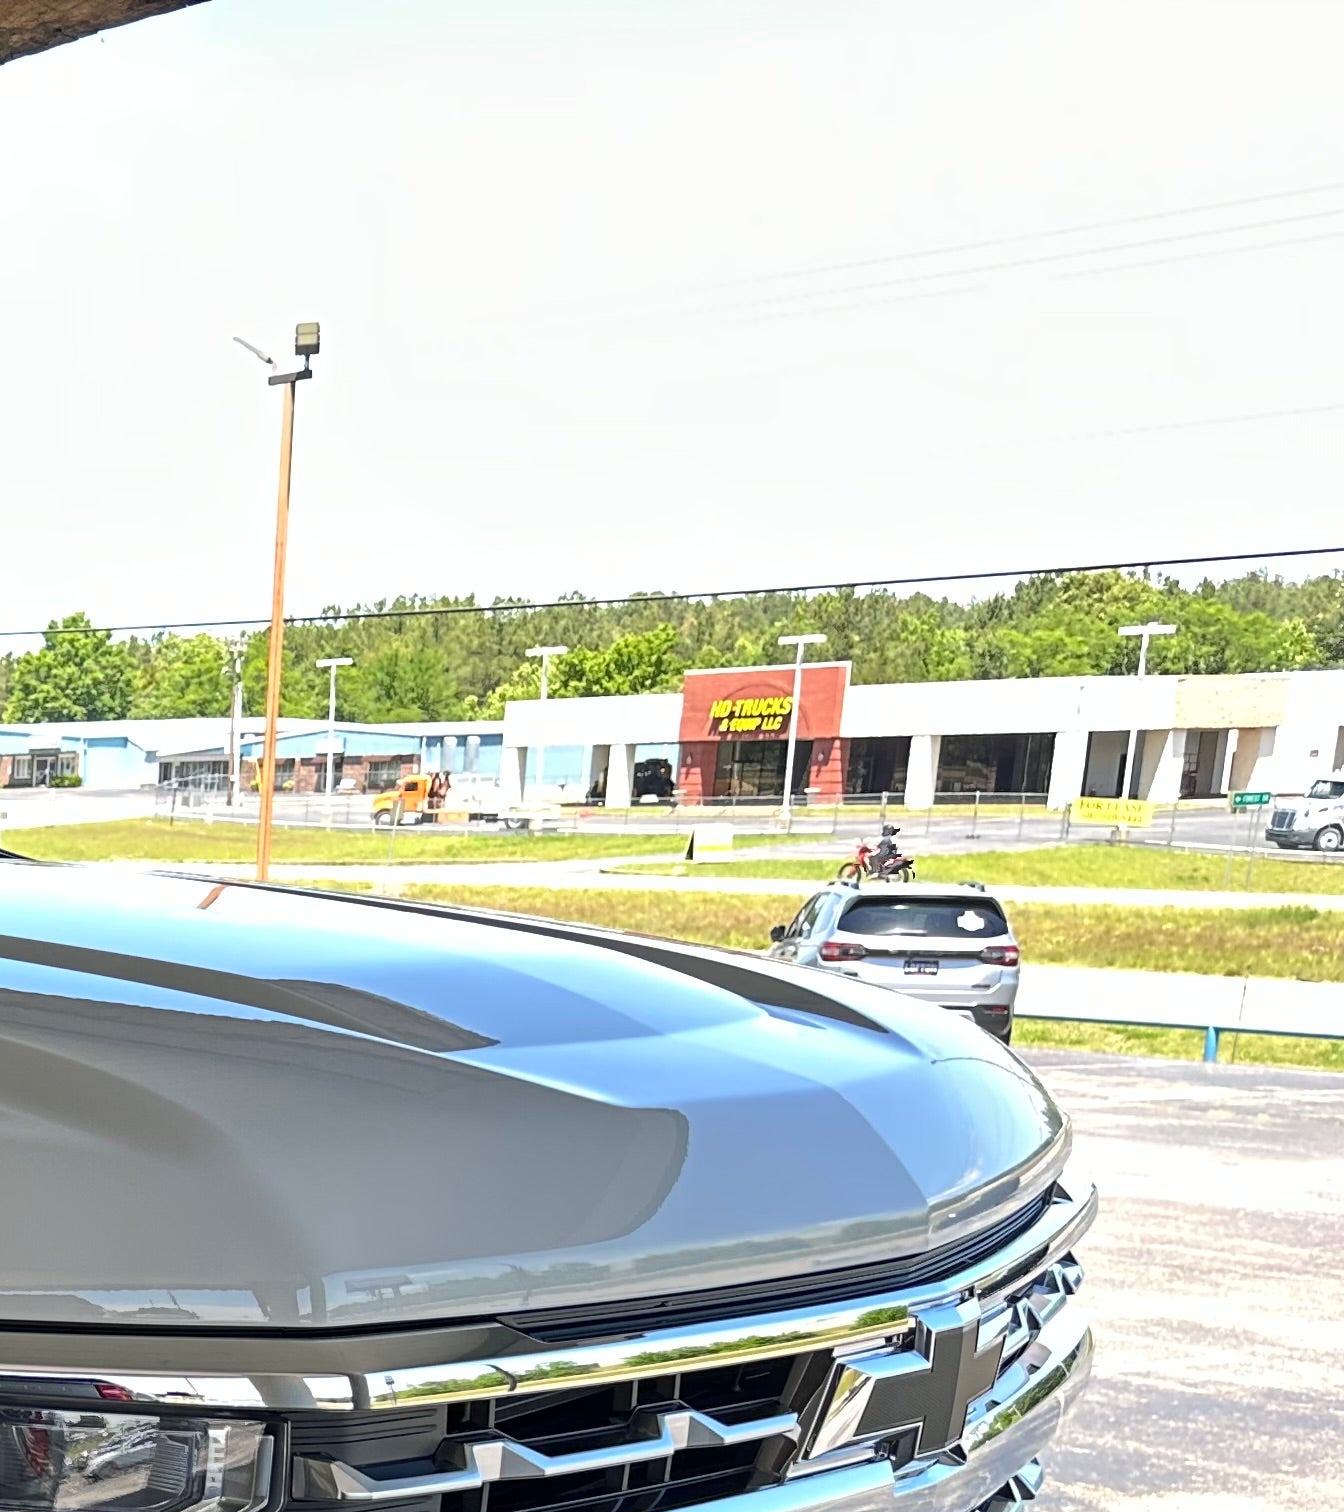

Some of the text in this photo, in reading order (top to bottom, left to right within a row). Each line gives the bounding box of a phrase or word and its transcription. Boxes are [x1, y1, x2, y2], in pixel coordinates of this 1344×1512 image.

[710, 696, 793, 718] HD TRUCKS
[719, 718, 729, 732] &
[761, 716, 783, 730] LLC
[1079, 799, 1104, 810] FOR
